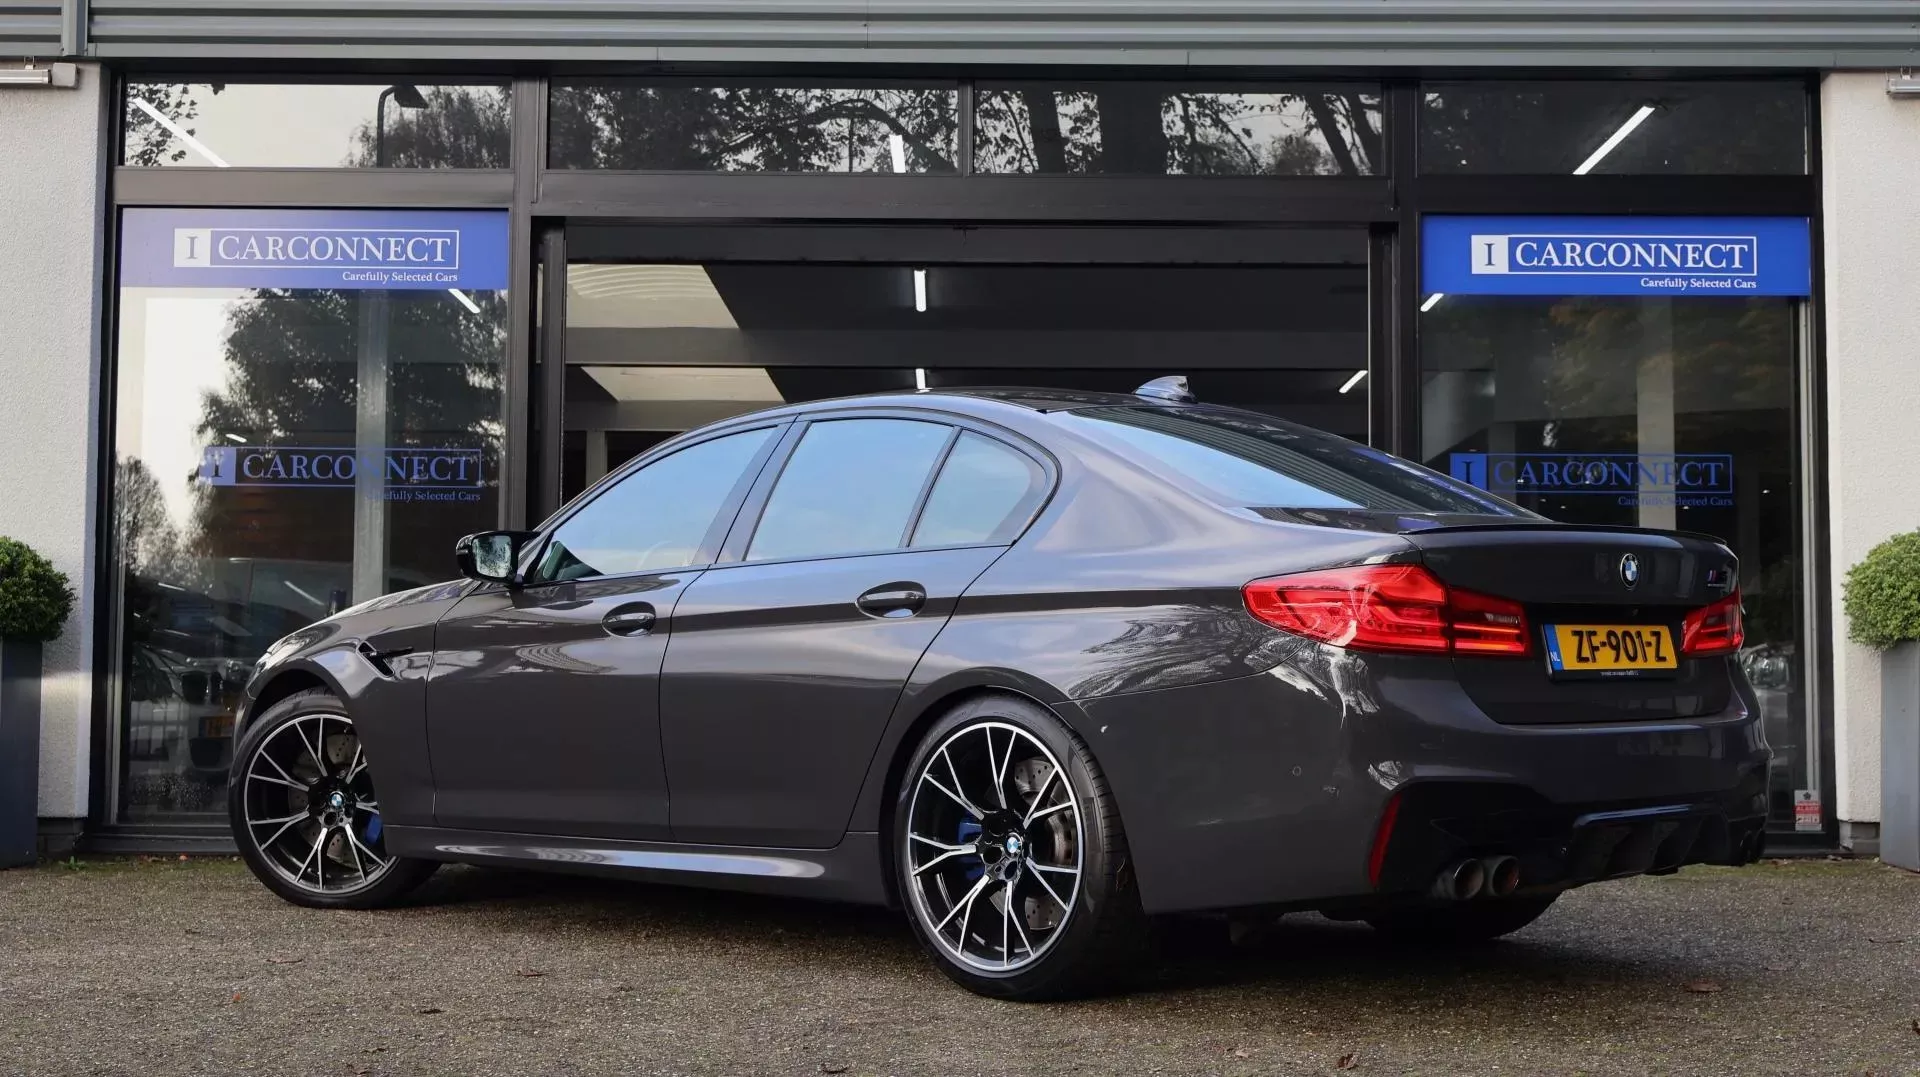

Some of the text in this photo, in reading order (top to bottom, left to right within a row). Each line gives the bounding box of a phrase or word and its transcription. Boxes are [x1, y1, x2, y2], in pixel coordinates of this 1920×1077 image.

[186, 234, 451, 263] I CARCONNECT
[1483, 240, 1748, 269] I CARCONNECT
[342, 271, 458, 284] Carefully Selected Cars
[1640, 277, 1757, 290] Carefully Selected Cars
[242, 453, 473, 481] CARCONNECT
[1493, 460, 1724, 486] CARCONNECT
[415, 490, 456, 502] Selected
[458, 491, 481, 502] Cars
[1550, 629, 1668, 664] NL ZF-901-Z
